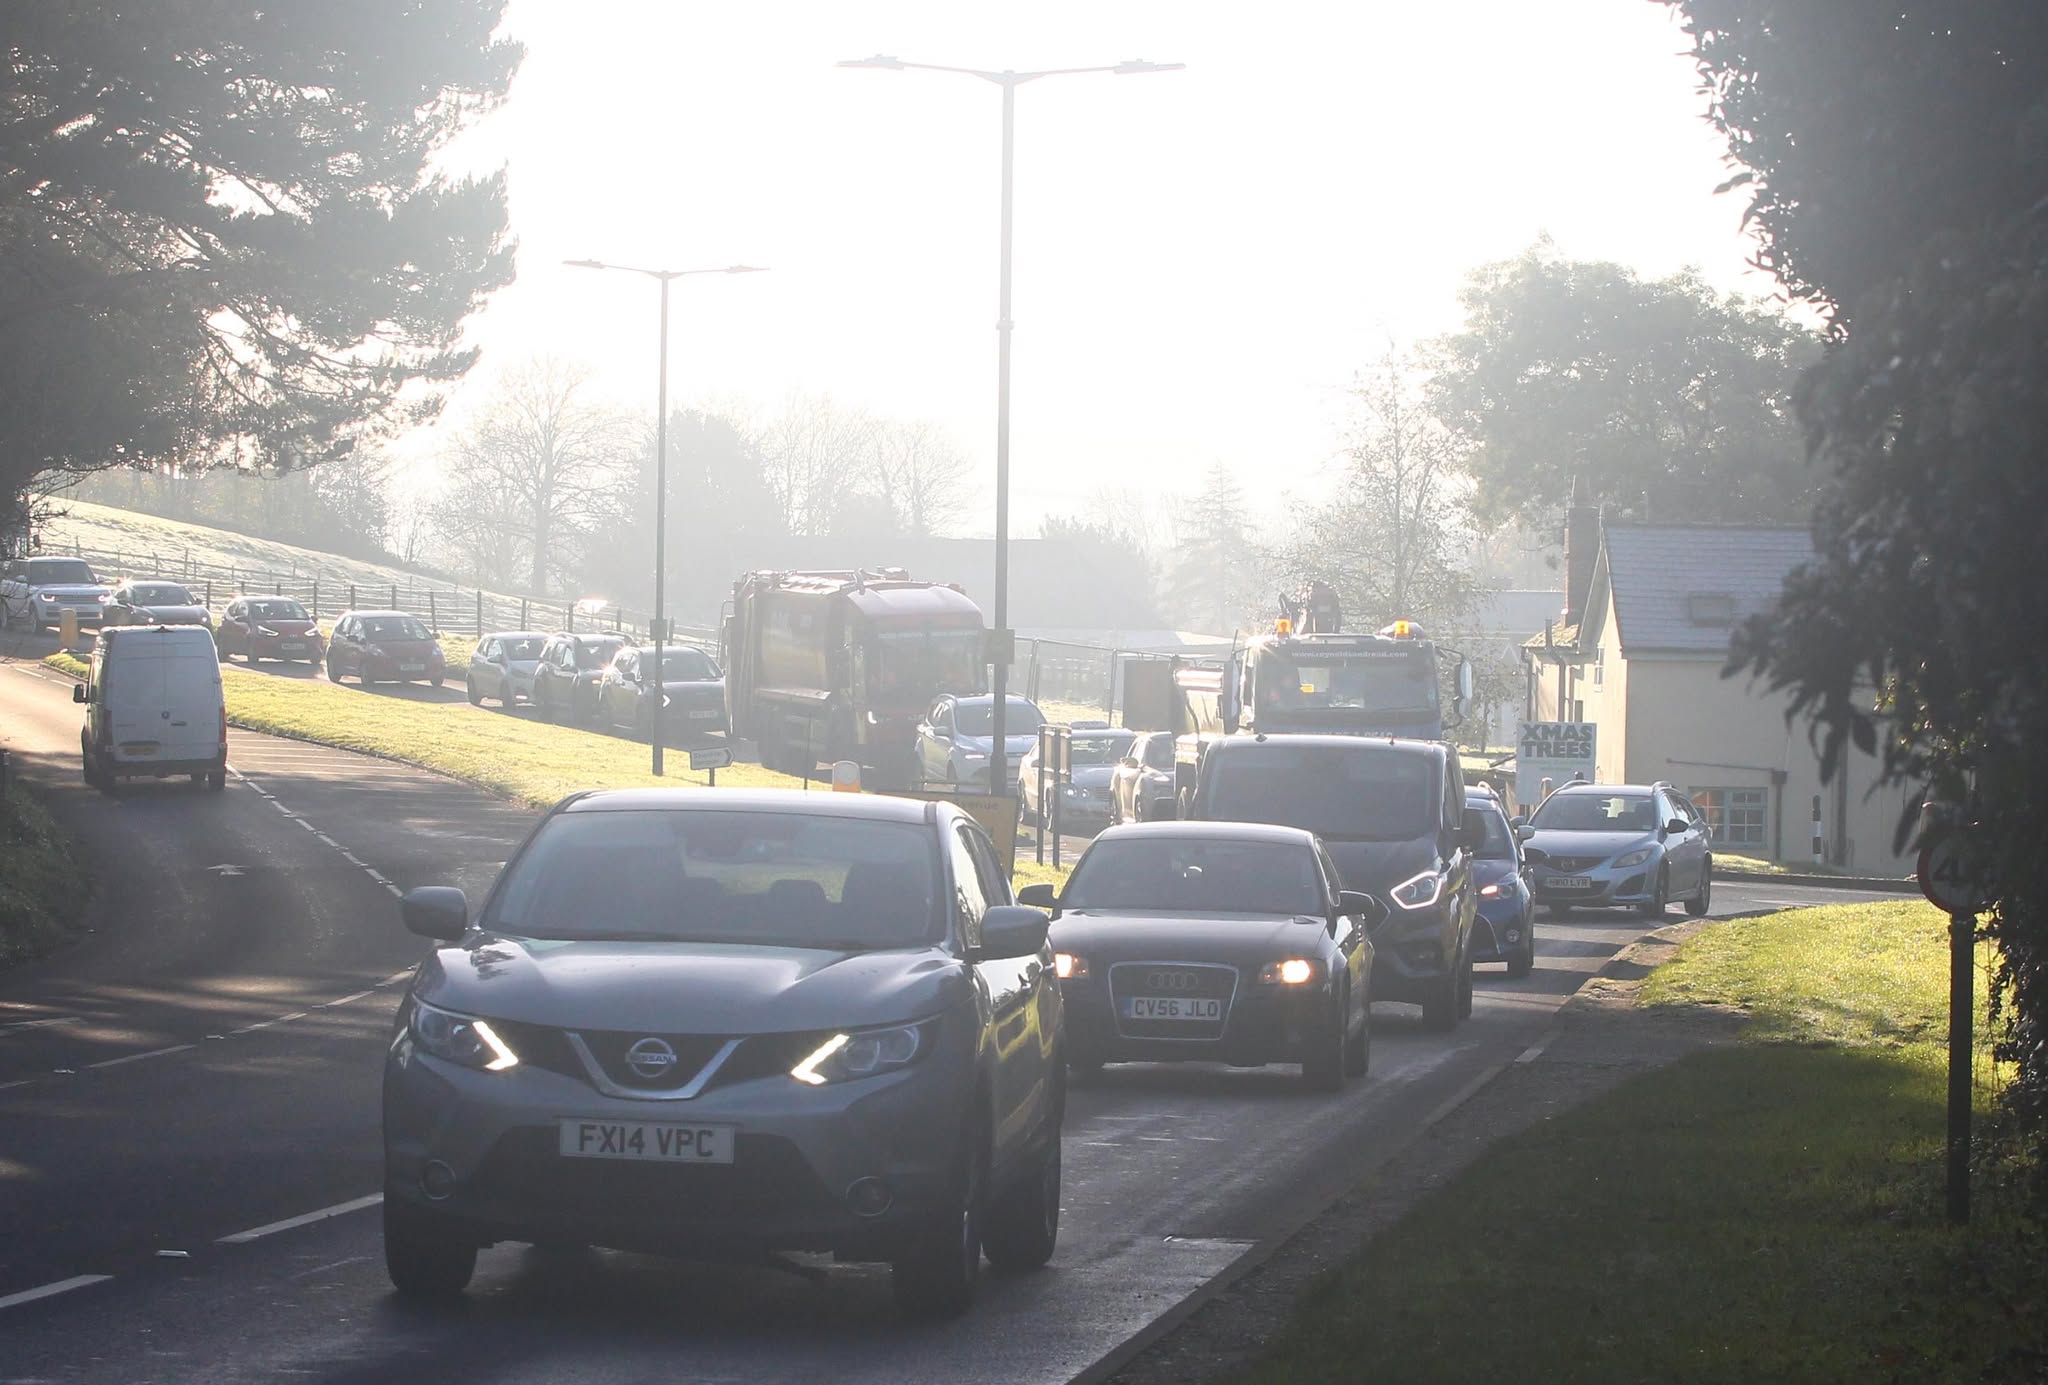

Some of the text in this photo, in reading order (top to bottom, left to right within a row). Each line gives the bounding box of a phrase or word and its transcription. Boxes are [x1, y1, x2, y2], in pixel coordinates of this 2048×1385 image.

[1521, 724, 1593, 741] XMAS
[1521, 741, 1592, 758] TREES
[1134, 999, 1218, 1017] CV56 JLO
[578, 1124, 714, 1157] FX14 VPC
